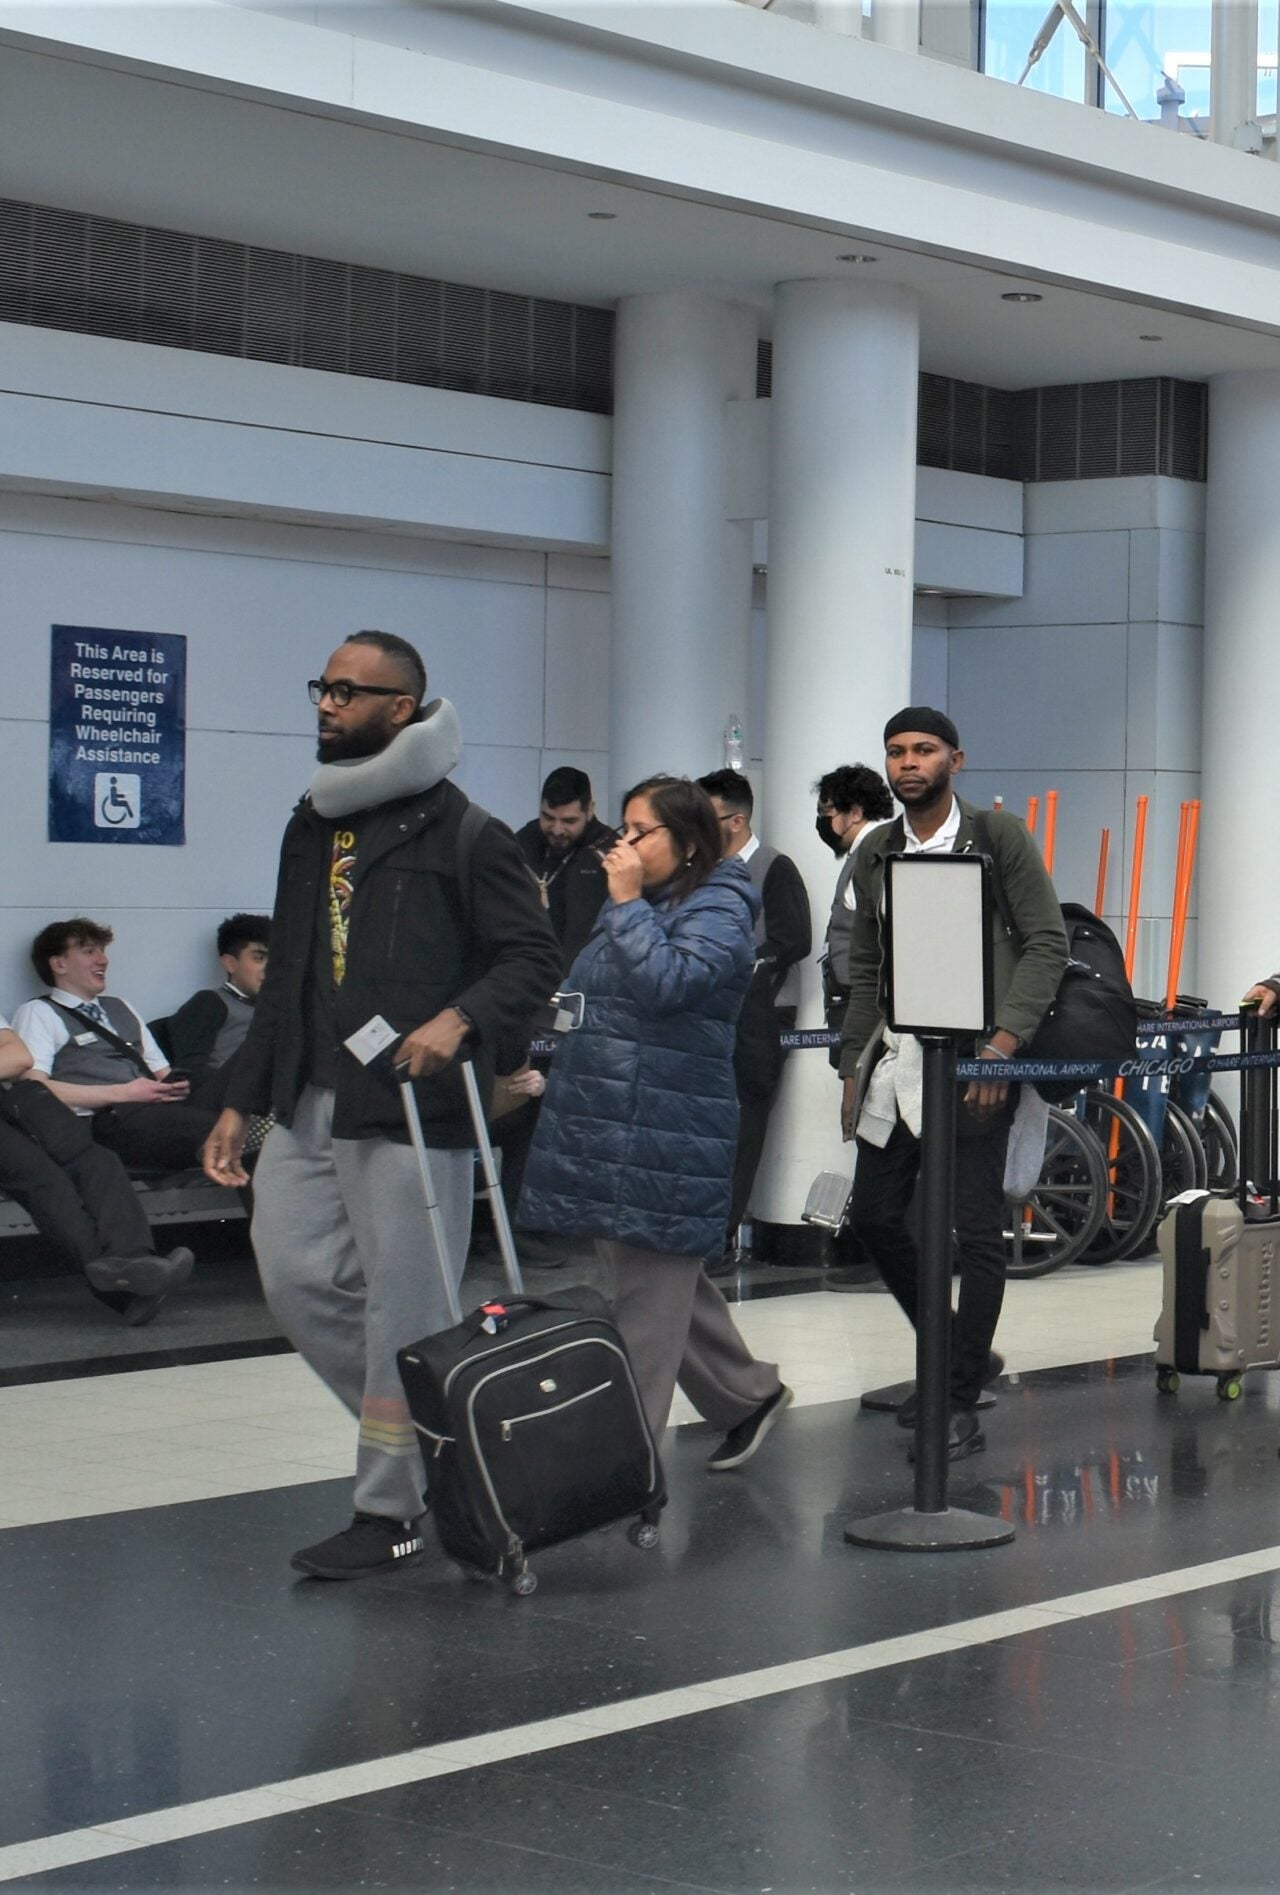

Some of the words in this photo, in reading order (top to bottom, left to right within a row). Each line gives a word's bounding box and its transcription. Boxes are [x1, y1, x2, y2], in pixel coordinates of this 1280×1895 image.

[75, 642, 108, 660] This
[112, 646, 147, 663] Area
[151, 649, 164, 664] is
[70, 662, 143, 682] Reserved
[147, 668, 168, 684] for
[74, 684, 164, 706] Passengers
[81, 705, 157, 727] Requiring
[75, 724, 162, 744] Wheelchair
[75, 746, 160, 764] Assistance
[1137, 1022, 1156, 1033] HARE
[1156, 1019, 1210, 1032] INTERNATIONAL
[1211, 1017, 1239, 1028] AIRPORT
[802, 1032, 841, 1045] INTERNA
[957, 1063, 980, 1076] HARE
[981, 1063, 1058, 1076] INTERNATIONAL
[1060, 1063, 1101, 1075] AIRPORT
[1118, 1057, 1195, 1077] CHICAGO
